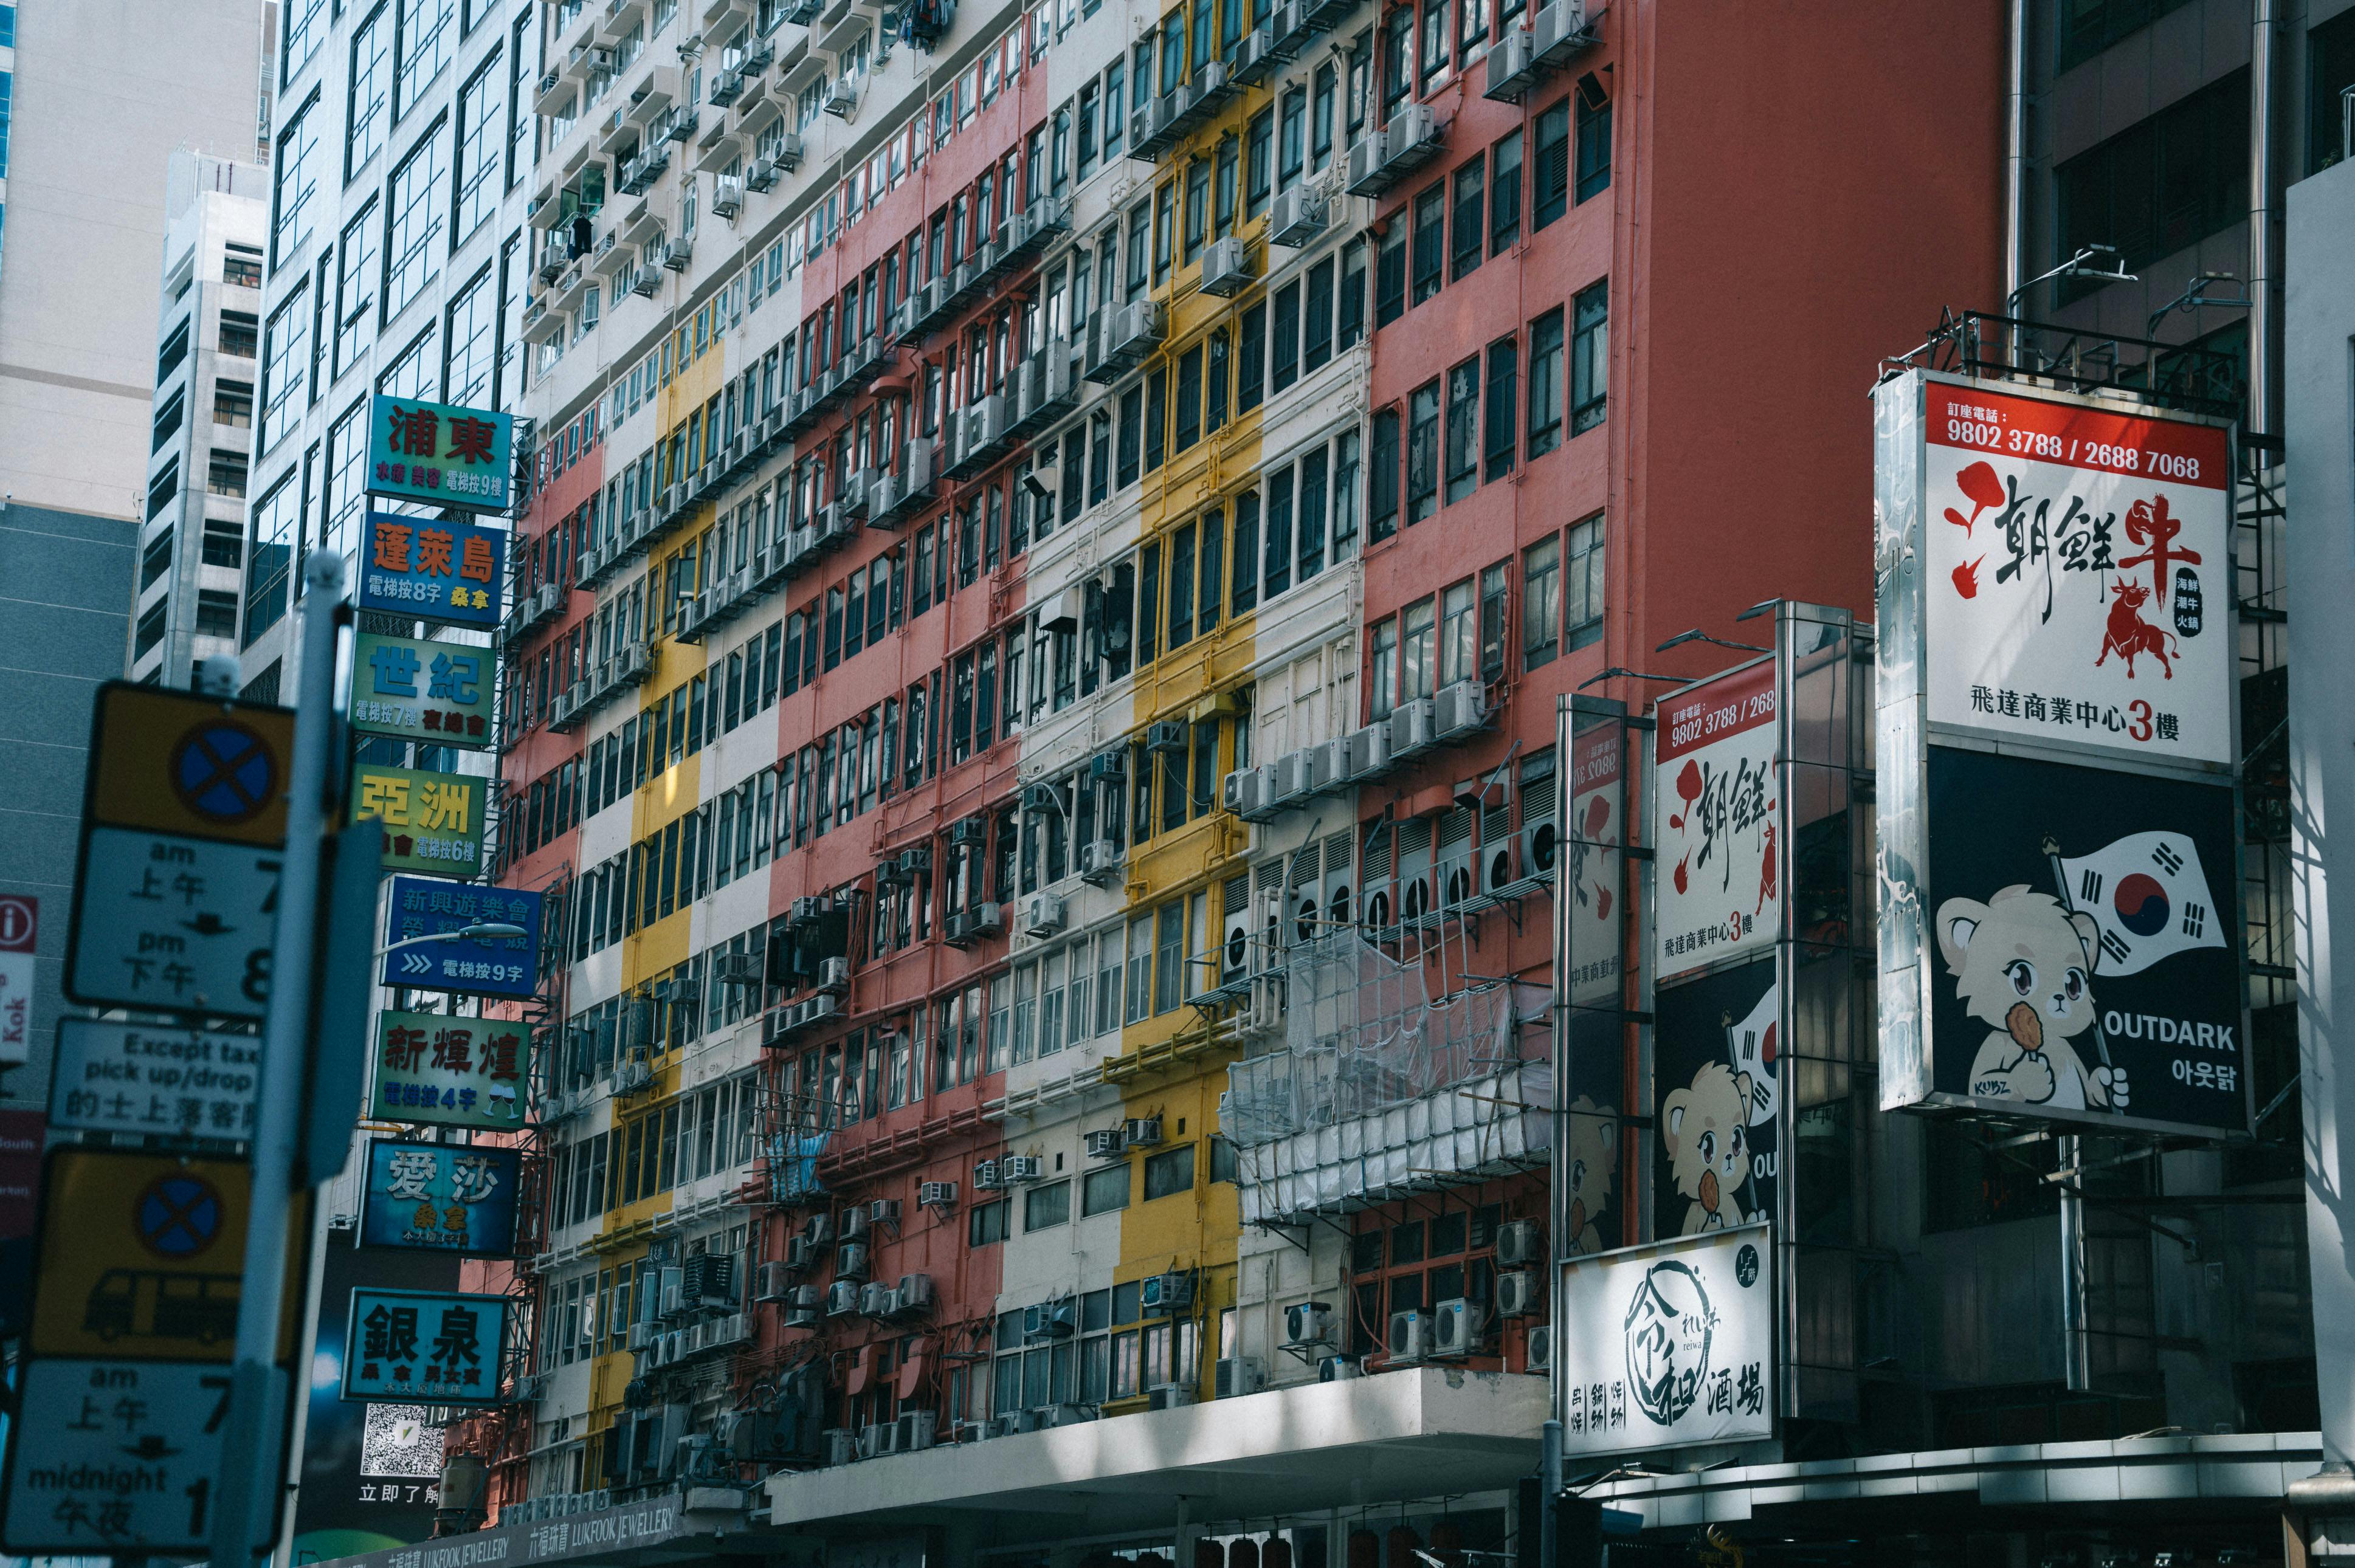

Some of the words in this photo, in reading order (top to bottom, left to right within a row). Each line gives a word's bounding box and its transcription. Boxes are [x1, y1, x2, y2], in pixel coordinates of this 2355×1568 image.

[388, 404, 497, 464] 浦東
[1948, 419, 2001, 448] 9802
[2008, 429, 2063, 458] 3788
[2069, 437, 2077, 461] /
[2085, 441, 2138, 471] 2688
[2146, 451, 2199, 480] 7068
[376, 461, 405, 484] 水療
[411, 466, 441, 488] 美容
[446, 470, 502, 497] 電梯按9樓
[373, 521, 495, 583] 蓬萊島
[368, 574, 441, 603] 電梯按8字
[450, 586, 490, 609] 桑拿
[2177, 614, 2199, 630] 火鍋
[370, 646, 479, 705] 世紀
[356, 700, 417, 727] 電梯按7樓
[422, 709, 485, 737] 夜總會
[1672, 718, 1702, 748] 9802
[1705, 704, 1737, 734] 3788
[1971, 684, 2179, 742] 飛達商業中心3樓
[357, 774, 471, 833] 亞洲
[150, 842, 196, 865] am
[417, 836, 475, 863] 電梯按6樓
[129, 867, 207, 907] 上午
[404, 887, 529, 923] 新興遊樂會
[137, 932, 185, 955] pm
[1664, 910, 1753, 959] 飛達商業中心3樓
[122, 957, 198, 995] 下午
[443, 960, 523, 983] 電梯按9字
[2, 996, 26, 1044] Kok
[2105, 1010, 2236, 1051] OUTDARK
[124, 1033, 212, 1061] Except
[384, 1025, 520, 1081] 新輝煌
[85, 1060, 140, 1085] pick
[148, 1065, 252, 1093] up/drop
[1974, 1081, 2012, 1097] KUBZ
[2173, 1060, 2236, 1093] 아웃닭
[384, 1082, 477, 1112] 電梯按4字
[386, 1150, 500, 1203] 愛莎
[413, 1203, 468, 1231] 桑拿
[364, 1304, 481, 1366] 銀泉
[1683, 1340, 1702, 1352] reiwa
[89, 1367, 139, 1389] am
[384, 1383, 462, 1396] 本大廈地庫
[1707, 1361, 1764, 1416] 酒場
[66, 1395, 149, 1432] 上午
[200, 1375, 233, 1434] 7
[28, 1463, 167, 1494] midnight
[52, 1496, 133, 1538] 午夜
[528, 1521, 569, 1559] 六福珠寶
[572, 1516, 616, 1547] LUKFOOK
[616, 1506, 675, 1544] JEWELLERY
[461, 1537, 509, 1568] JEWELLERY
